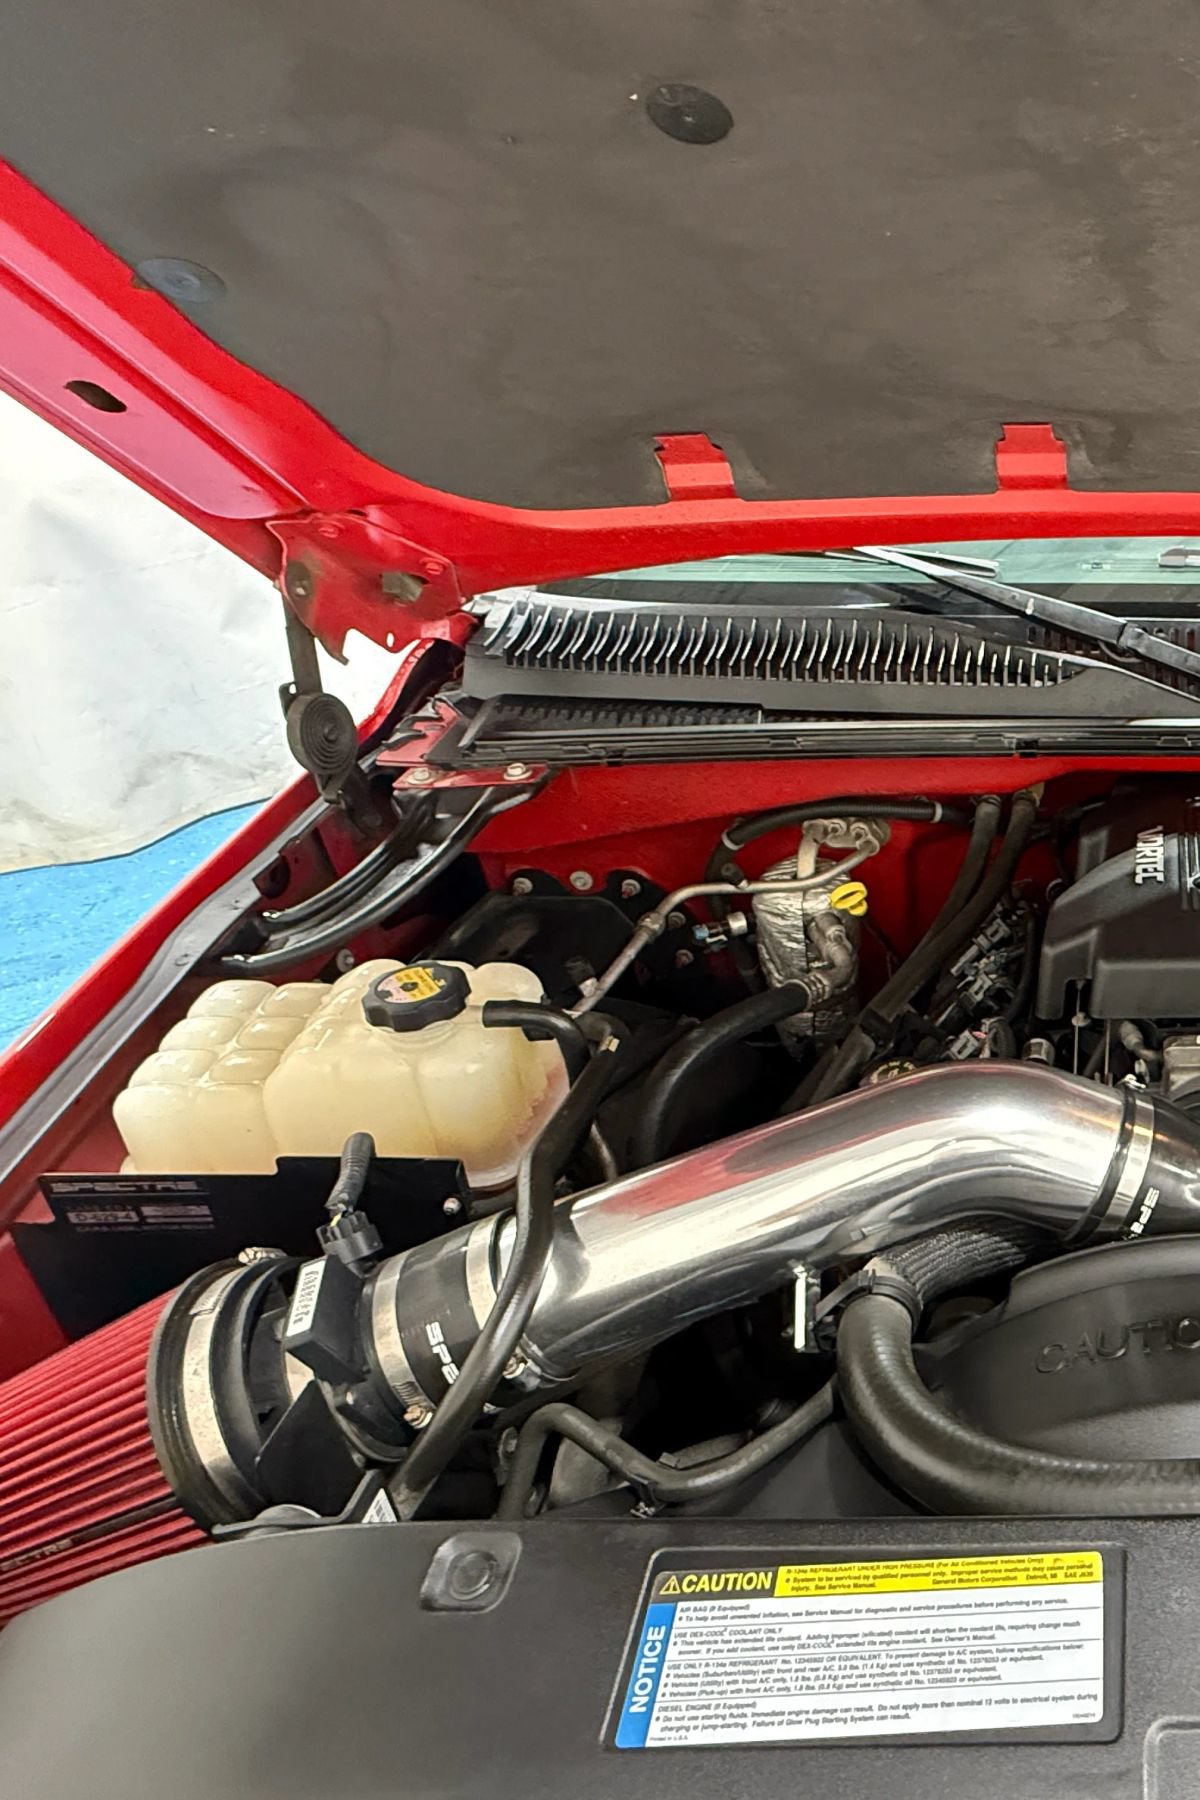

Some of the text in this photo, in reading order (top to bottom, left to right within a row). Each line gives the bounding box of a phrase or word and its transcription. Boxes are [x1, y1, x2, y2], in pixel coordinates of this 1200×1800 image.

[1134, 824, 1165, 885] VORTEC
[50, 1180, 198, 1193] SPECTRE
[681, 1571, 774, 1593] CAUTION
[628, 1624, 667, 1715] NOTICE
